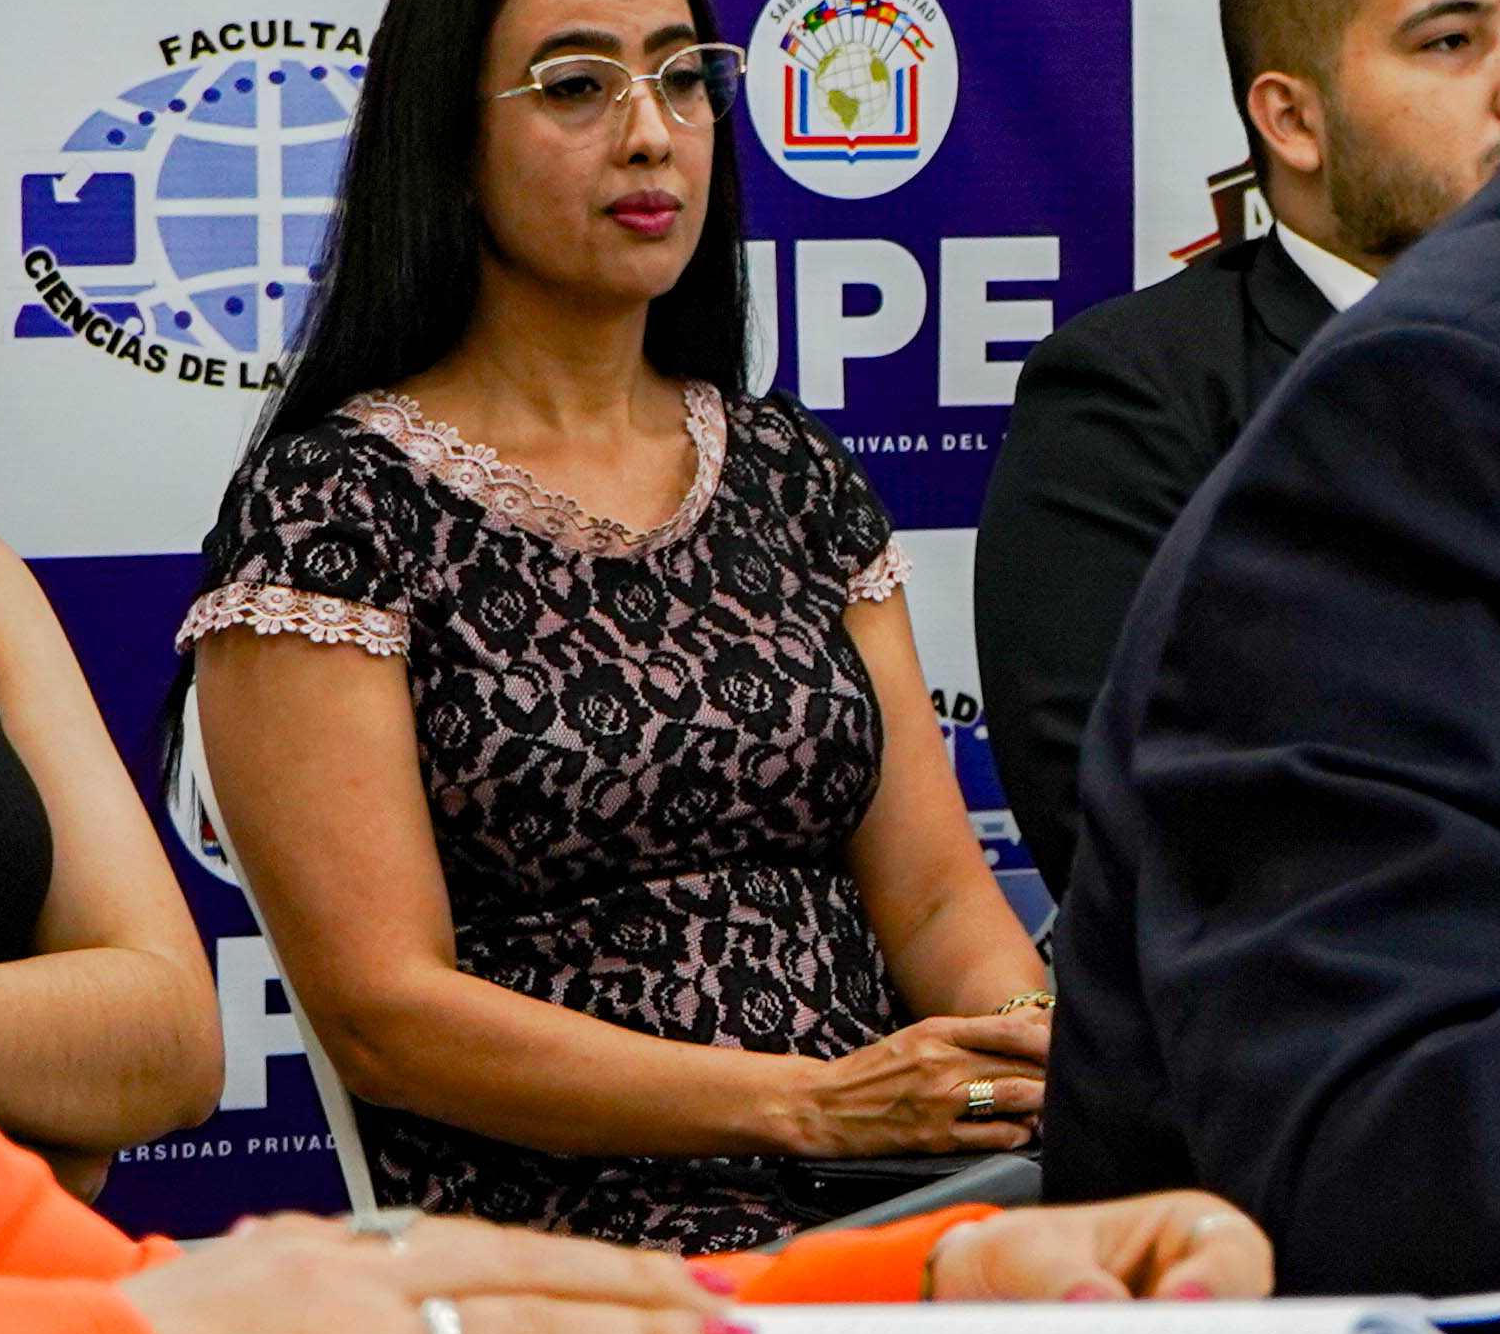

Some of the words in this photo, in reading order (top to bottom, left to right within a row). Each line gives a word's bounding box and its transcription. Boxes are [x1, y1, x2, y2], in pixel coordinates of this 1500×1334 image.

[159, 20, 366, 65] FACULTA
[24, 250, 168, 373] CIENCIAS
[178, 352, 226, 387] DE
[240, 362, 287, 390] LA
[842, 434, 929, 453] RIVADA
[942, 433, 988, 452] DEL
[119, 1140, 233, 1163] ERSIDAD
[248, 1134, 337, 1155] PRIVAD
